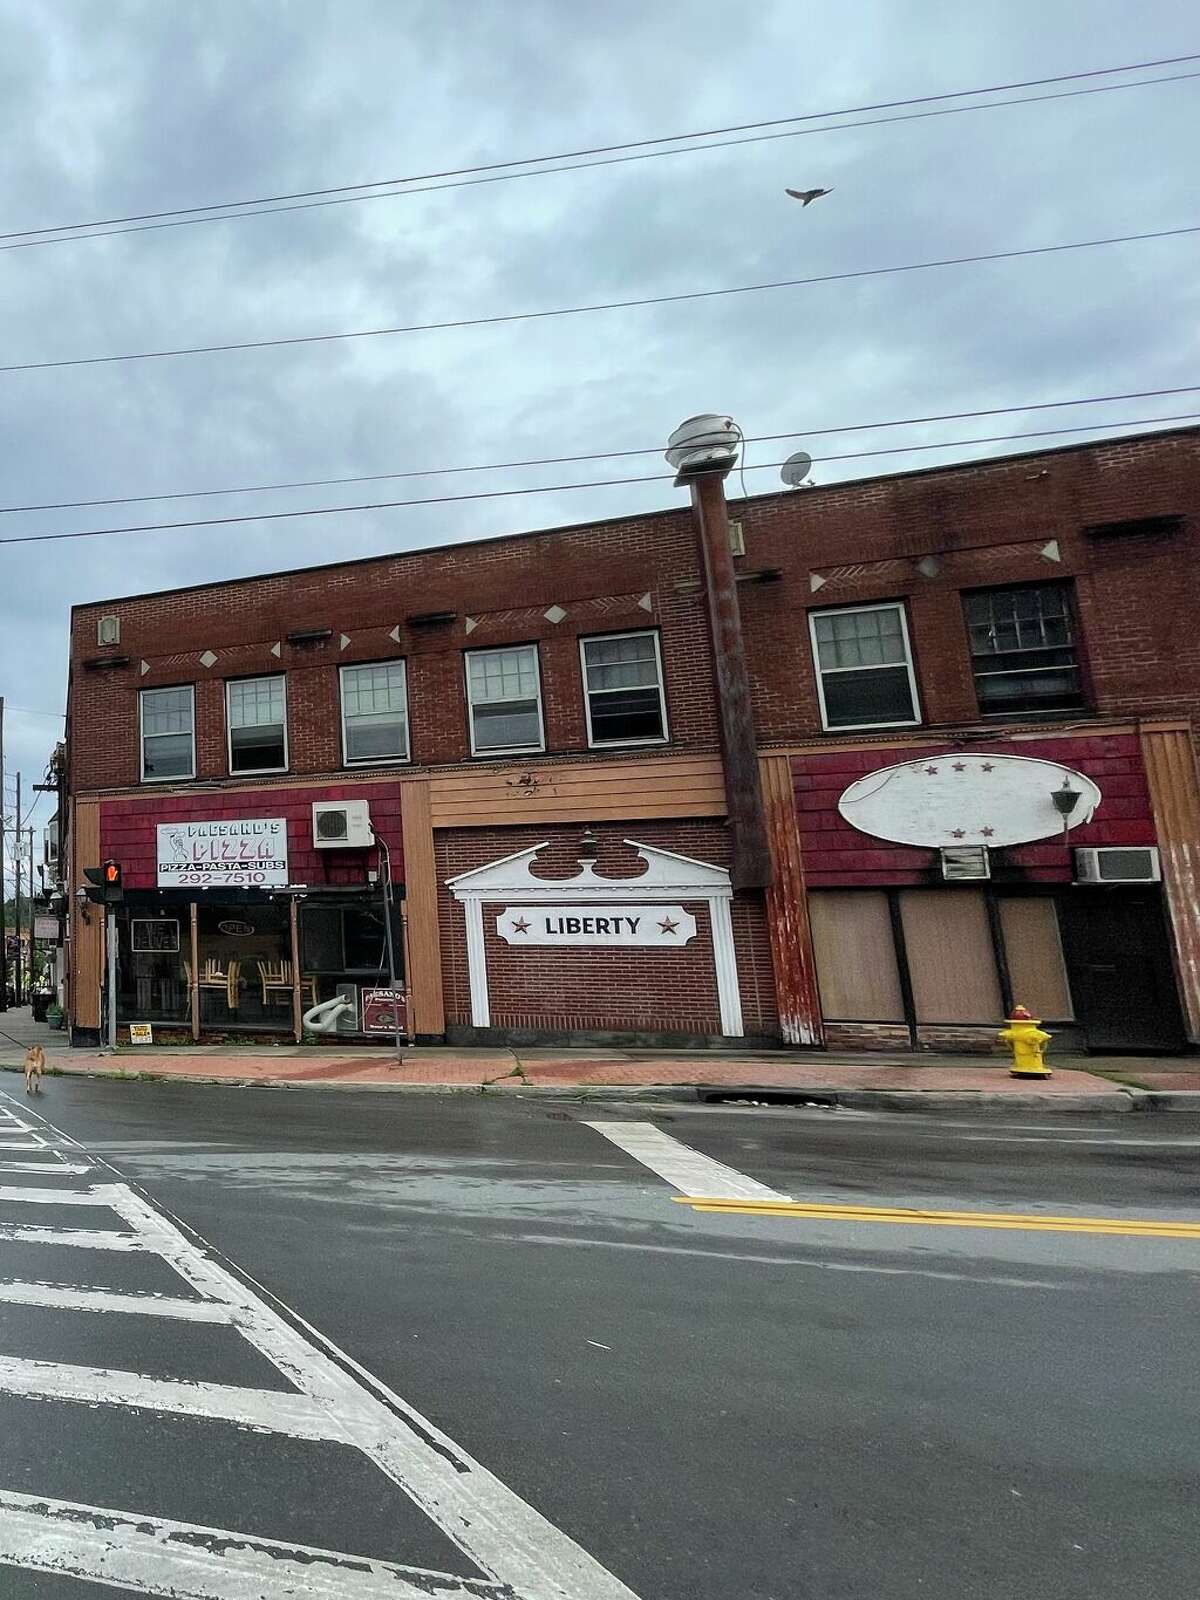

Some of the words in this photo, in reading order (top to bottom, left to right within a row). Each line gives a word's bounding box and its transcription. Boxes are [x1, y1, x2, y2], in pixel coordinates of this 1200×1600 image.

[192, 838, 275, 860] PIZZA
[178, 872, 266, 884] 292-7510
[545, 917, 641, 935] LIBERTY
